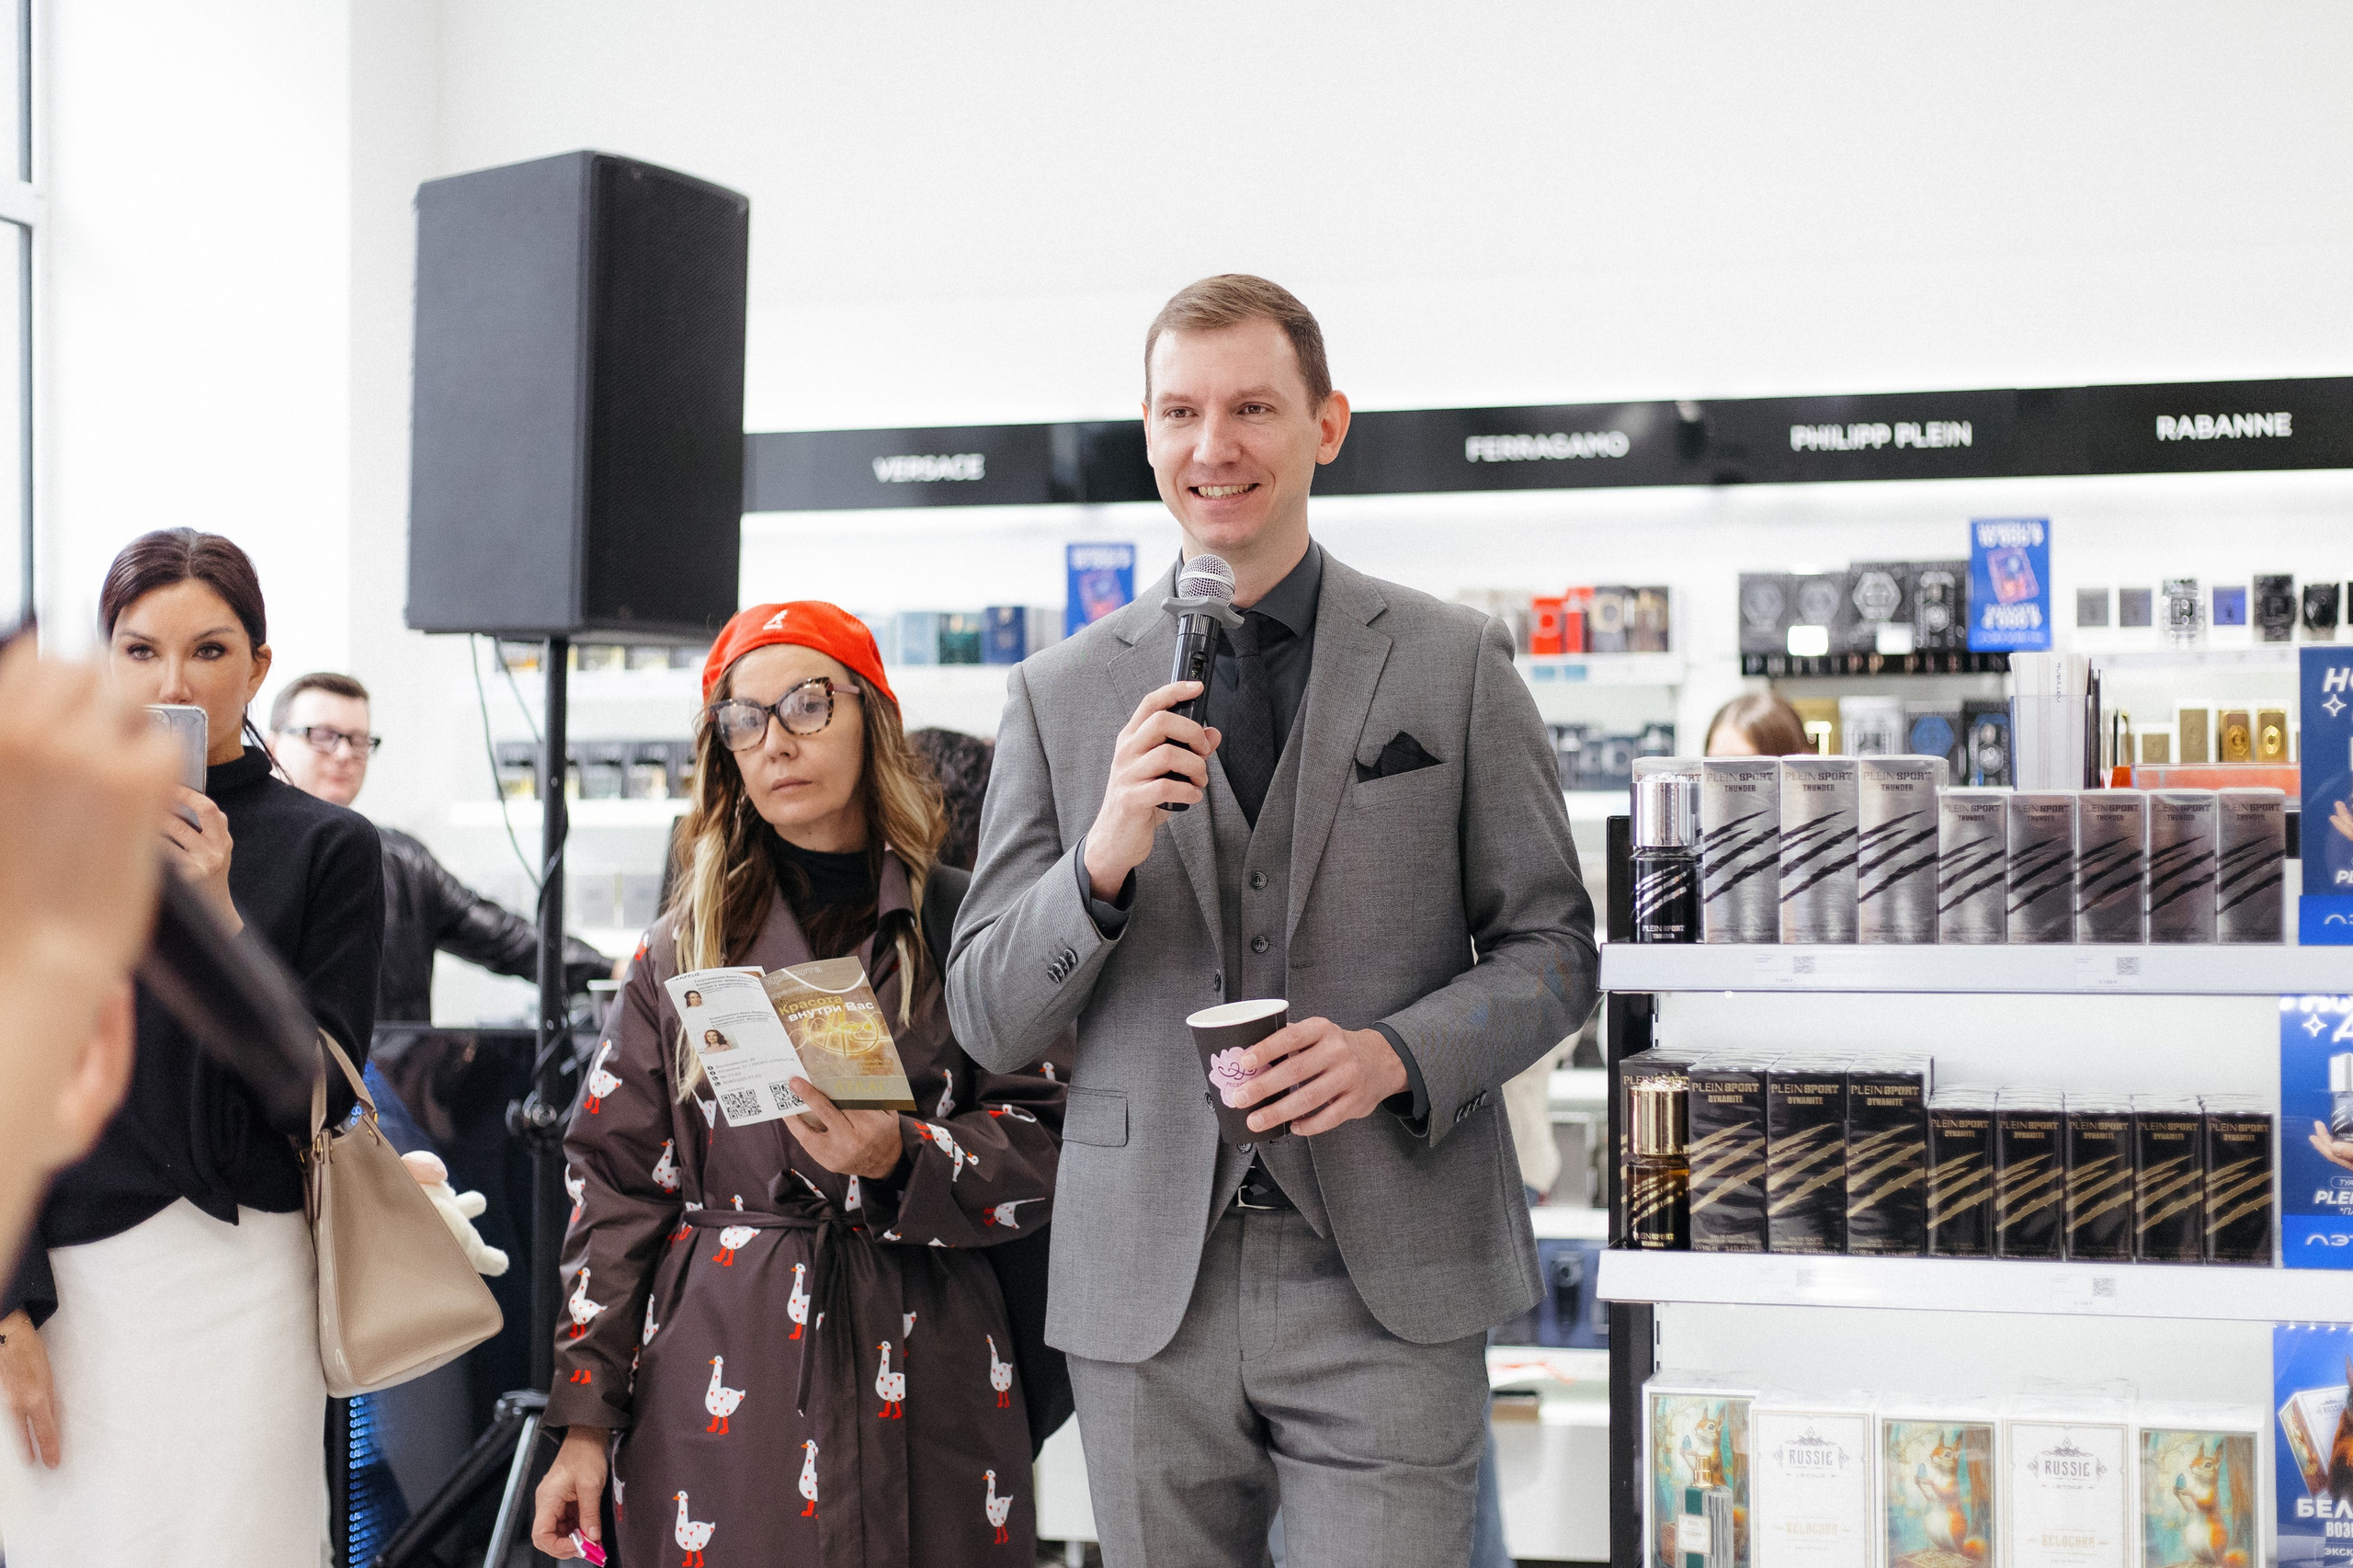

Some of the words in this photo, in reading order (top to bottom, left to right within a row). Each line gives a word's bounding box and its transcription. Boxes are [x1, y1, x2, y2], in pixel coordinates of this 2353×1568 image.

[2156, 412, 2292, 441] RABANNE
[1790, 423, 1892, 451] PHILIPP
[1894, 420, 1972, 449] PLEIN
[779, 995, 843, 1016] Красота
[788, 1005, 843, 1022] внутри
[845, 1001, 874, 1012] Вас
[1692, 1083, 1723, 1093] PLEIN
[1724, 1083, 1759, 1093] SPORT
[1771, 1084, 1803, 1094] PLEIN
[1803, 1085, 1839, 1094] SPORT
[1850, 1085, 1882, 1095] PLEIN
[1883, 1085, 1919, 1096] SPORT
[1789, 1449, 1833, 1466] RUSSIE
[2044, 1460, 2090, 1477] RUSSIE
